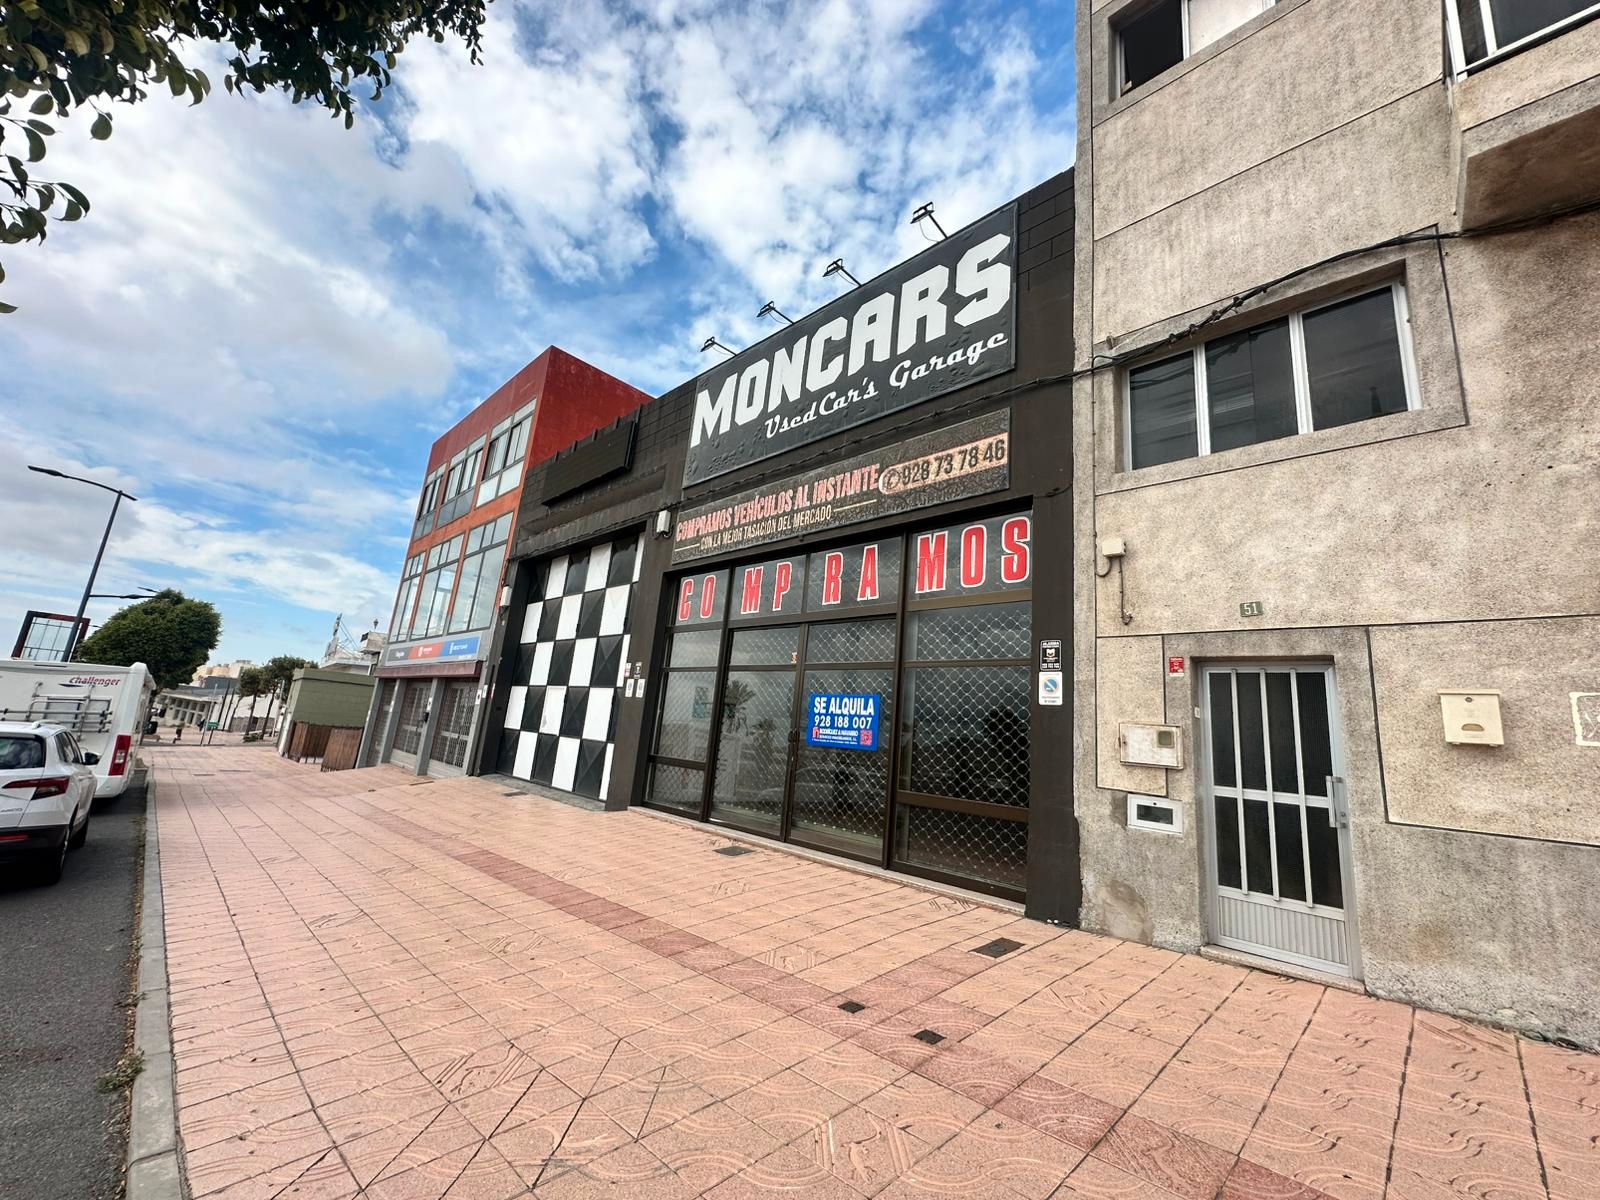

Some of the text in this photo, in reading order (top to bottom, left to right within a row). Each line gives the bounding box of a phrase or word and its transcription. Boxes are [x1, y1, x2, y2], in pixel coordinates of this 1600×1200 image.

[690, 233, 1011, 448] MONCARS
[889, 331, 1009, 388] Garage
[902, 439, 1005, 485] 928 73 78 46
[676, 463, 880, 542] COMPRAMOS VEHÍCULOS AL INSTANTE
[701, 504, 832, 550] CON LA MEJOR TASACIÓN DEL MERCADO
[1243, 603, 1258, 615] 51
[69, 676, 121, 688] challenger
[813, 696, 875, 716] SE ALQUILA
[814, 715, 873, 730] 928 188 007
